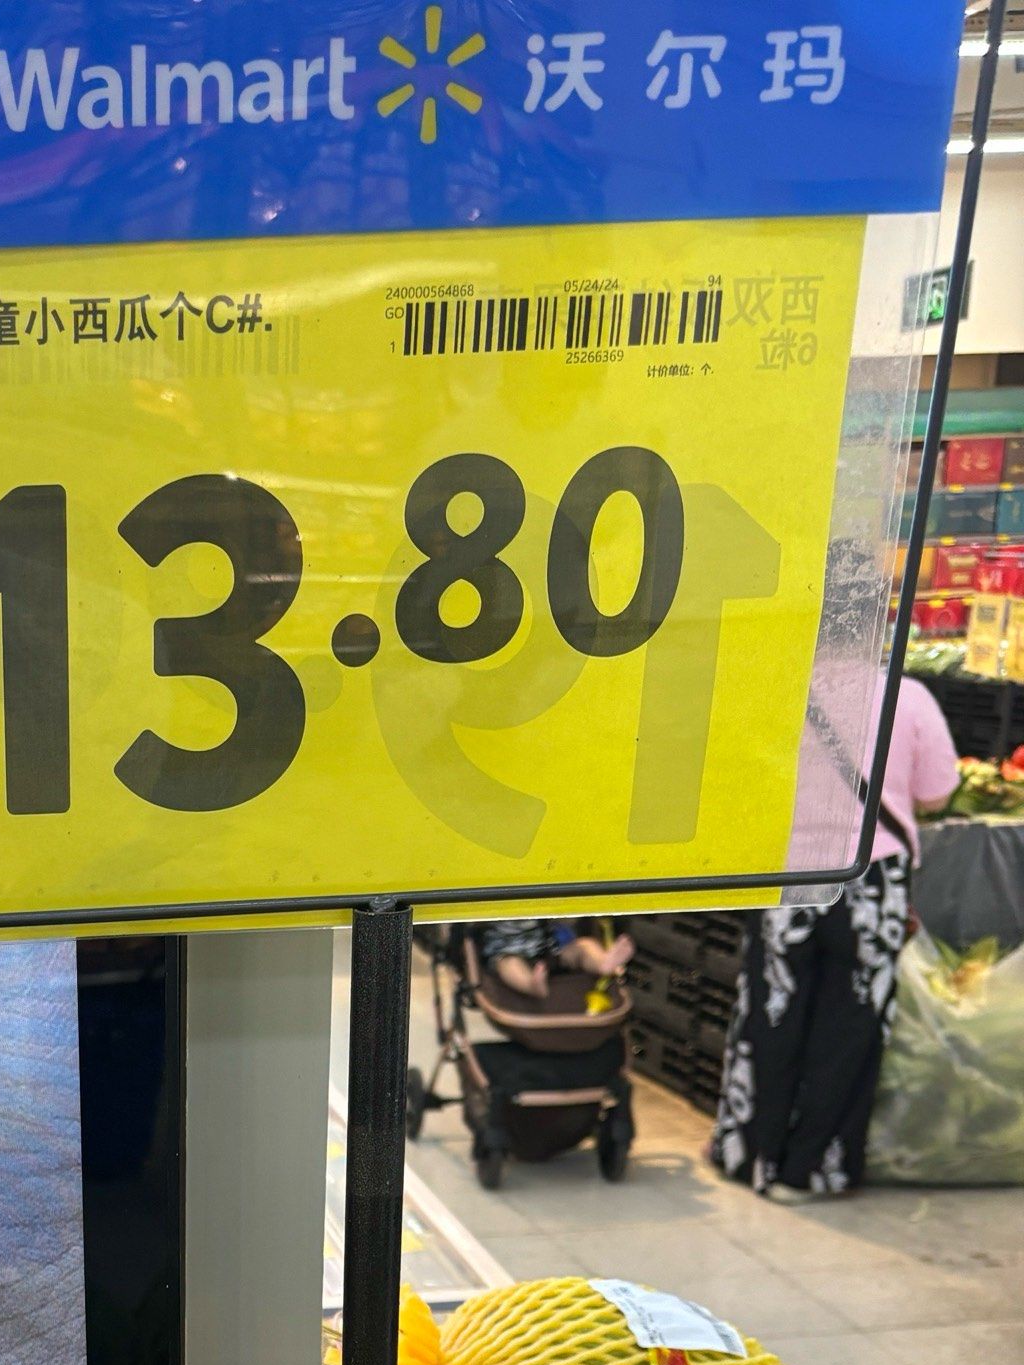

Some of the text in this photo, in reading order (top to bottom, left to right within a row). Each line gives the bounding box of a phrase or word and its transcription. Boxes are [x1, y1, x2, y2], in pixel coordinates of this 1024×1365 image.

[524, 25, 847, 112] 沃尔玛
[385, 274, 722, 301] 240000564868 05/24/24 94
[564, 349, 625, 365] 25266369
